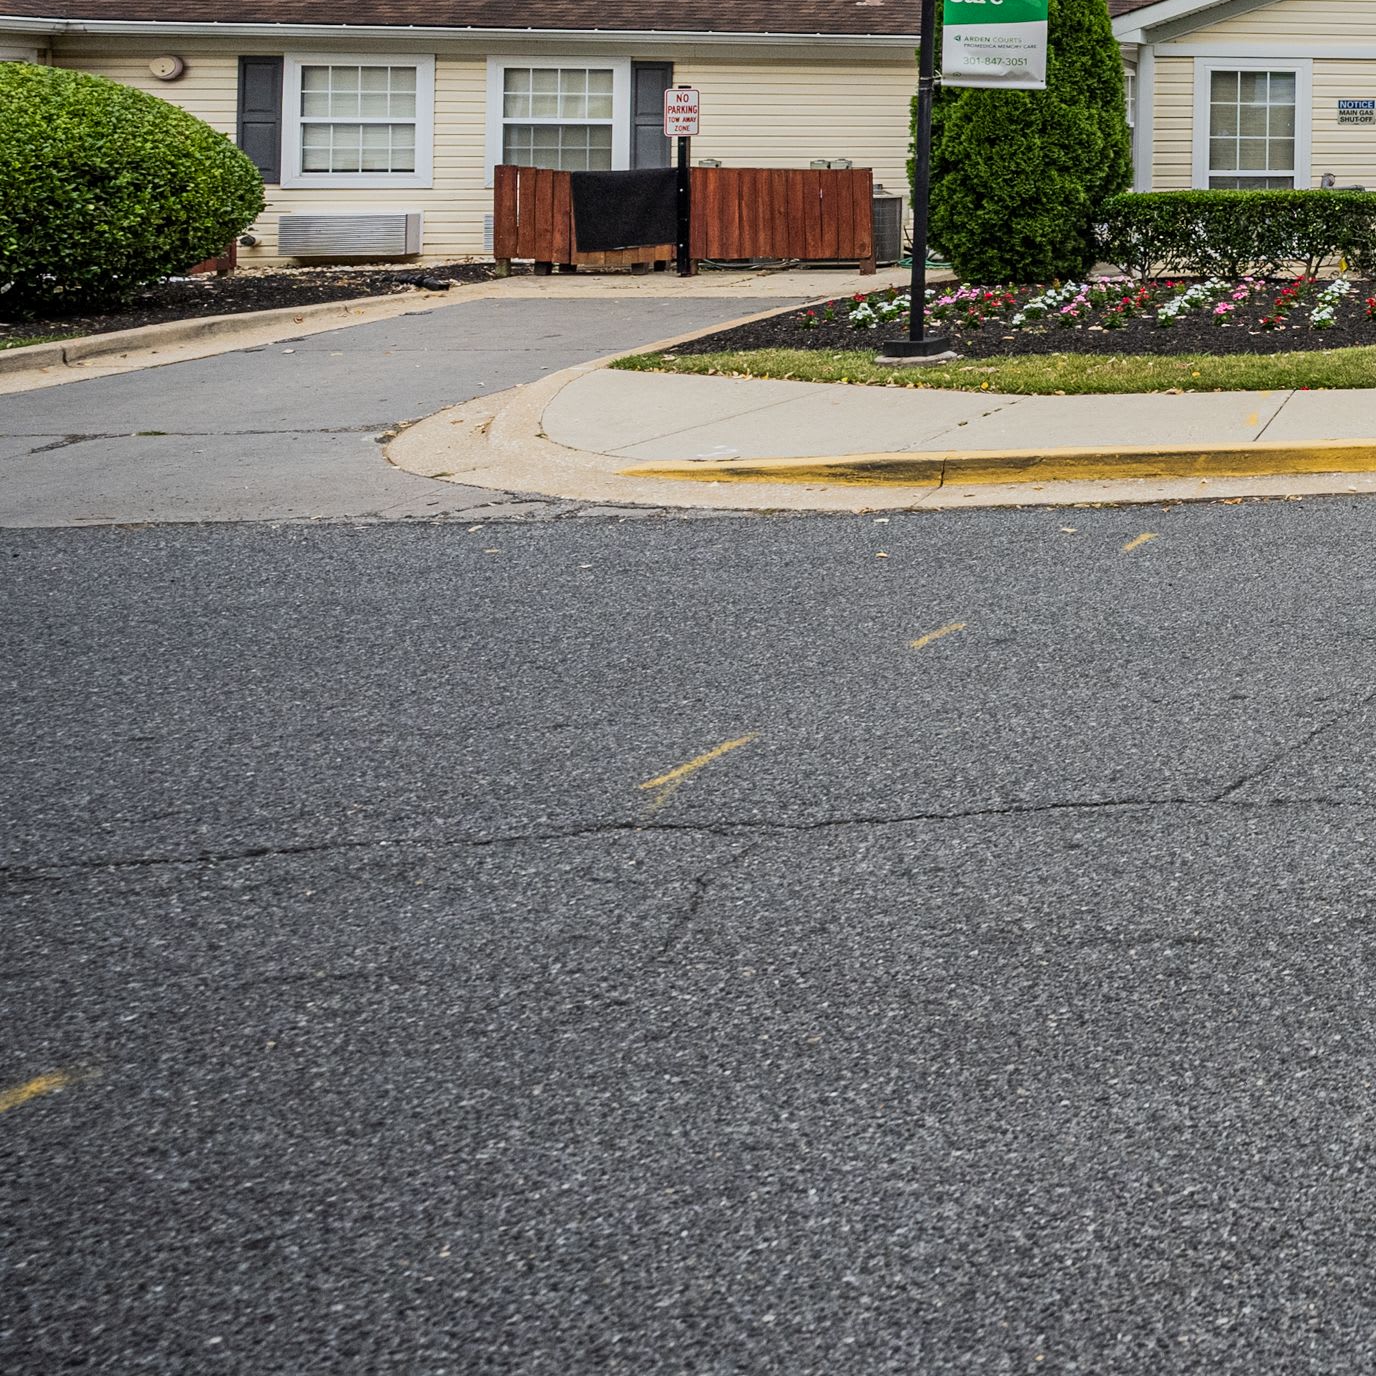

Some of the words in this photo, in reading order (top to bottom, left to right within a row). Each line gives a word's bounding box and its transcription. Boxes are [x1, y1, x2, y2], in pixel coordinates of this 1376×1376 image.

[963, 35, 991, 43] ARDEN
[992, 36, 1022, 44] COURTS
[962, 56, 1028, 66] 301-847-3051
[676, 94, 689, 103] NO
[667, 105, 698, 114] PARKING
[1339, 101, 1374, 109] NOTICE
